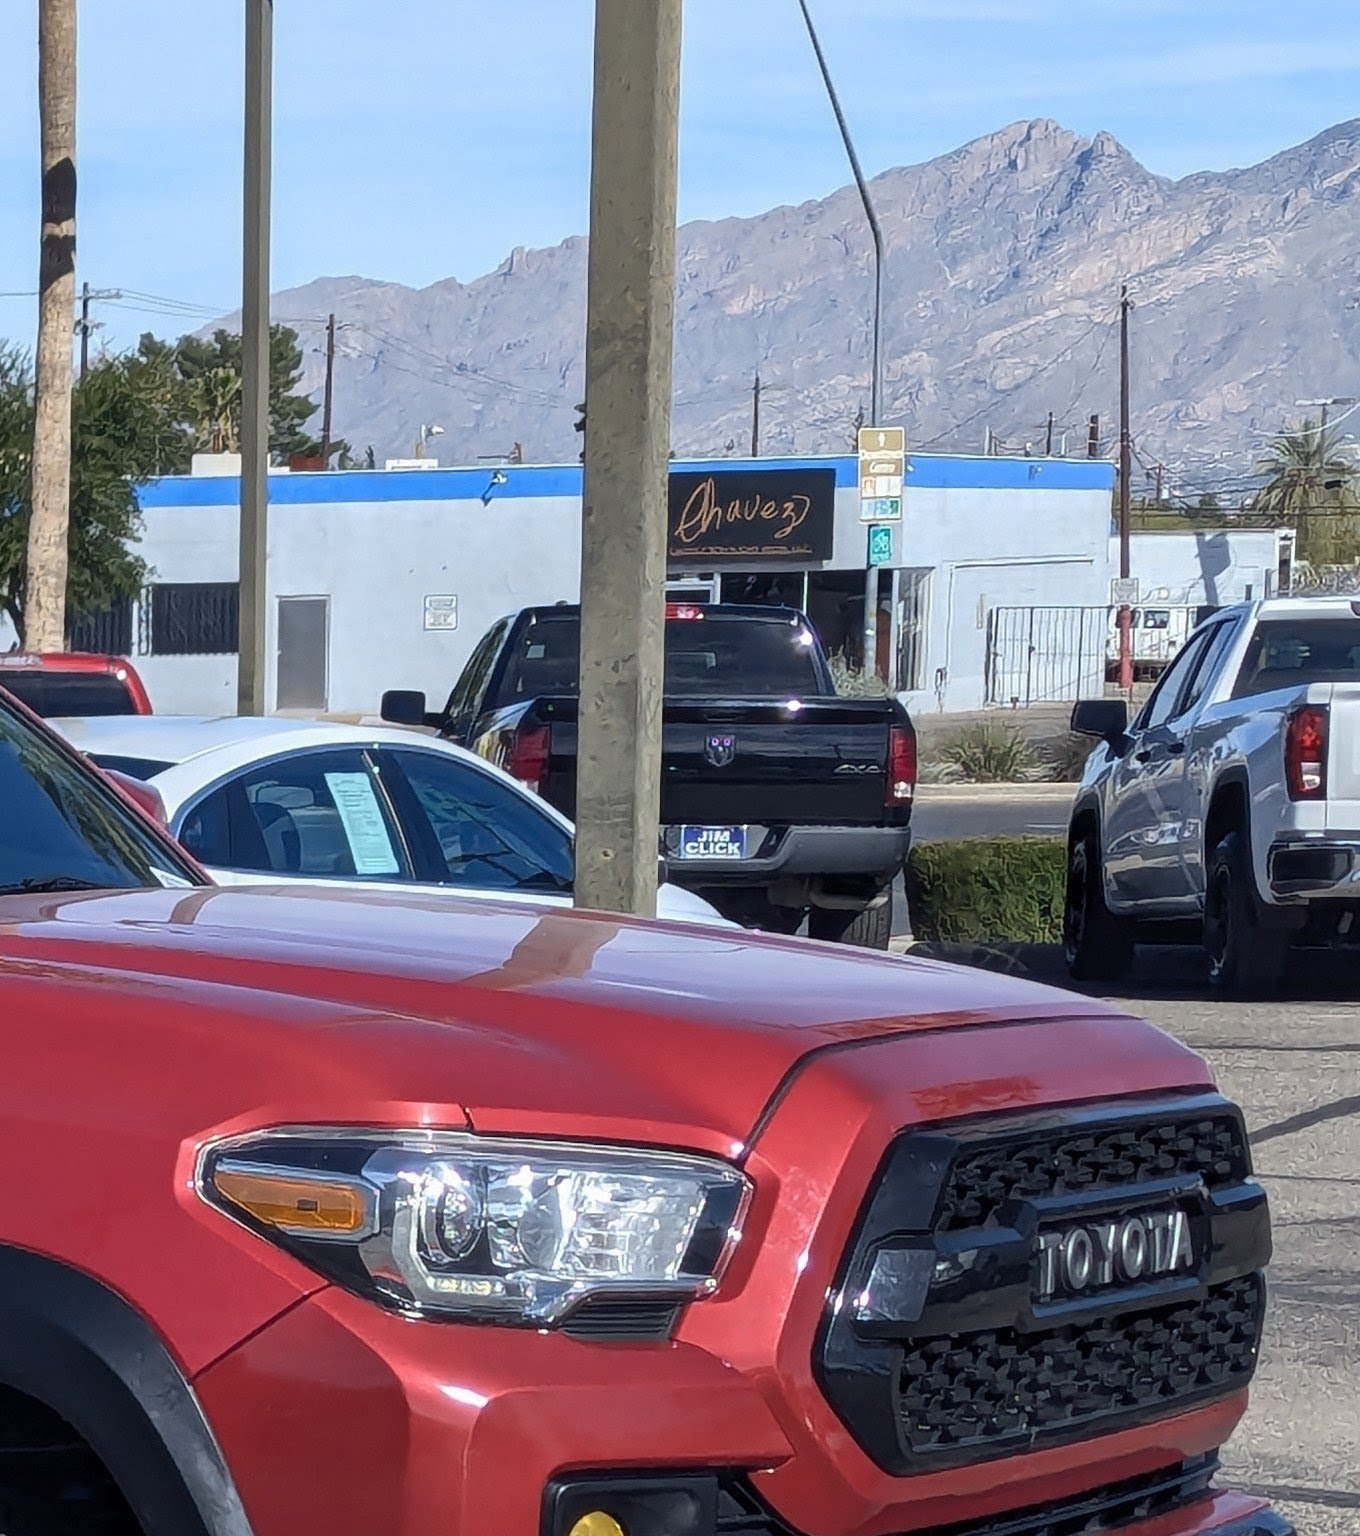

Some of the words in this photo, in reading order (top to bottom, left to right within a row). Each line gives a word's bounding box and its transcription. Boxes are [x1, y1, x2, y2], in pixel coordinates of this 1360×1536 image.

[673, 477, 811, 543] Chavez
[685, 841, 741, 855] CLICK
[697, 830, 730, 843] JIM
[1037, 1211, 1194, 1296] TOYOTA
